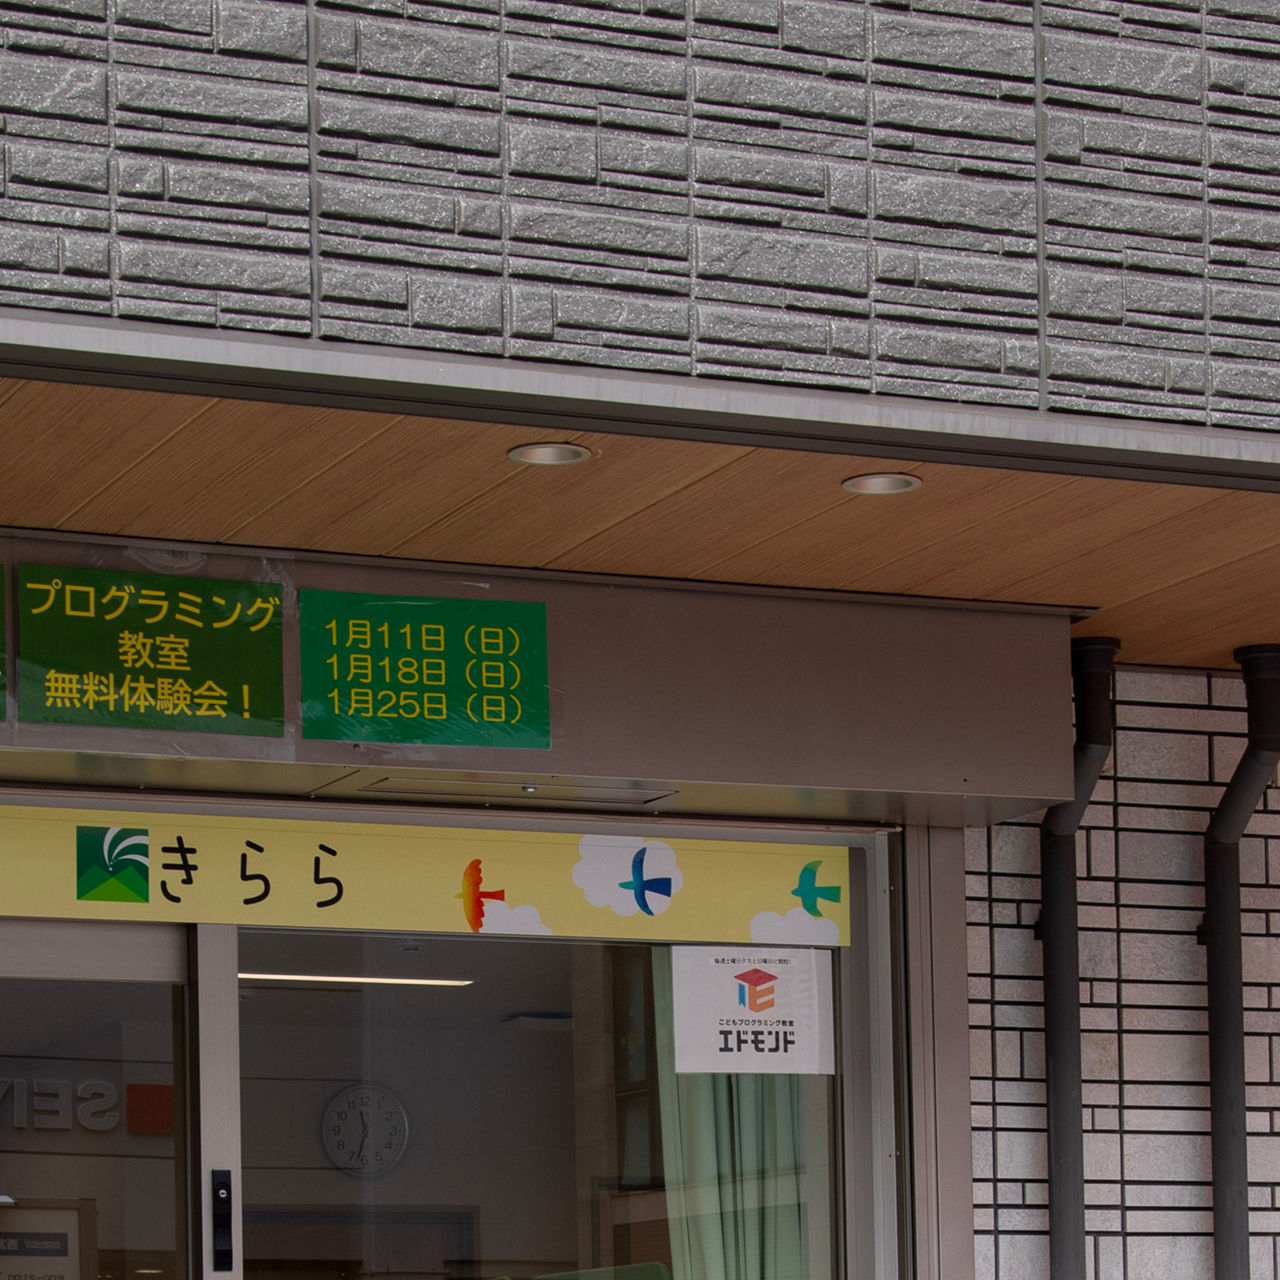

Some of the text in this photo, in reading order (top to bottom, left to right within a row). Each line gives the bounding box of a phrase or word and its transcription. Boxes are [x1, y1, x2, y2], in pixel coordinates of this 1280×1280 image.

[26, 578, 280, 633] プログラミング
[117, 631, 191, 671] 教室
[44, 674, 251, 719] 無料体験会!
[160, 835, 343, 908] きらら
[718, 1018, 795, 1028] こどもプログラミング教室
[719, 1030, 796, 1053] エドモンド
